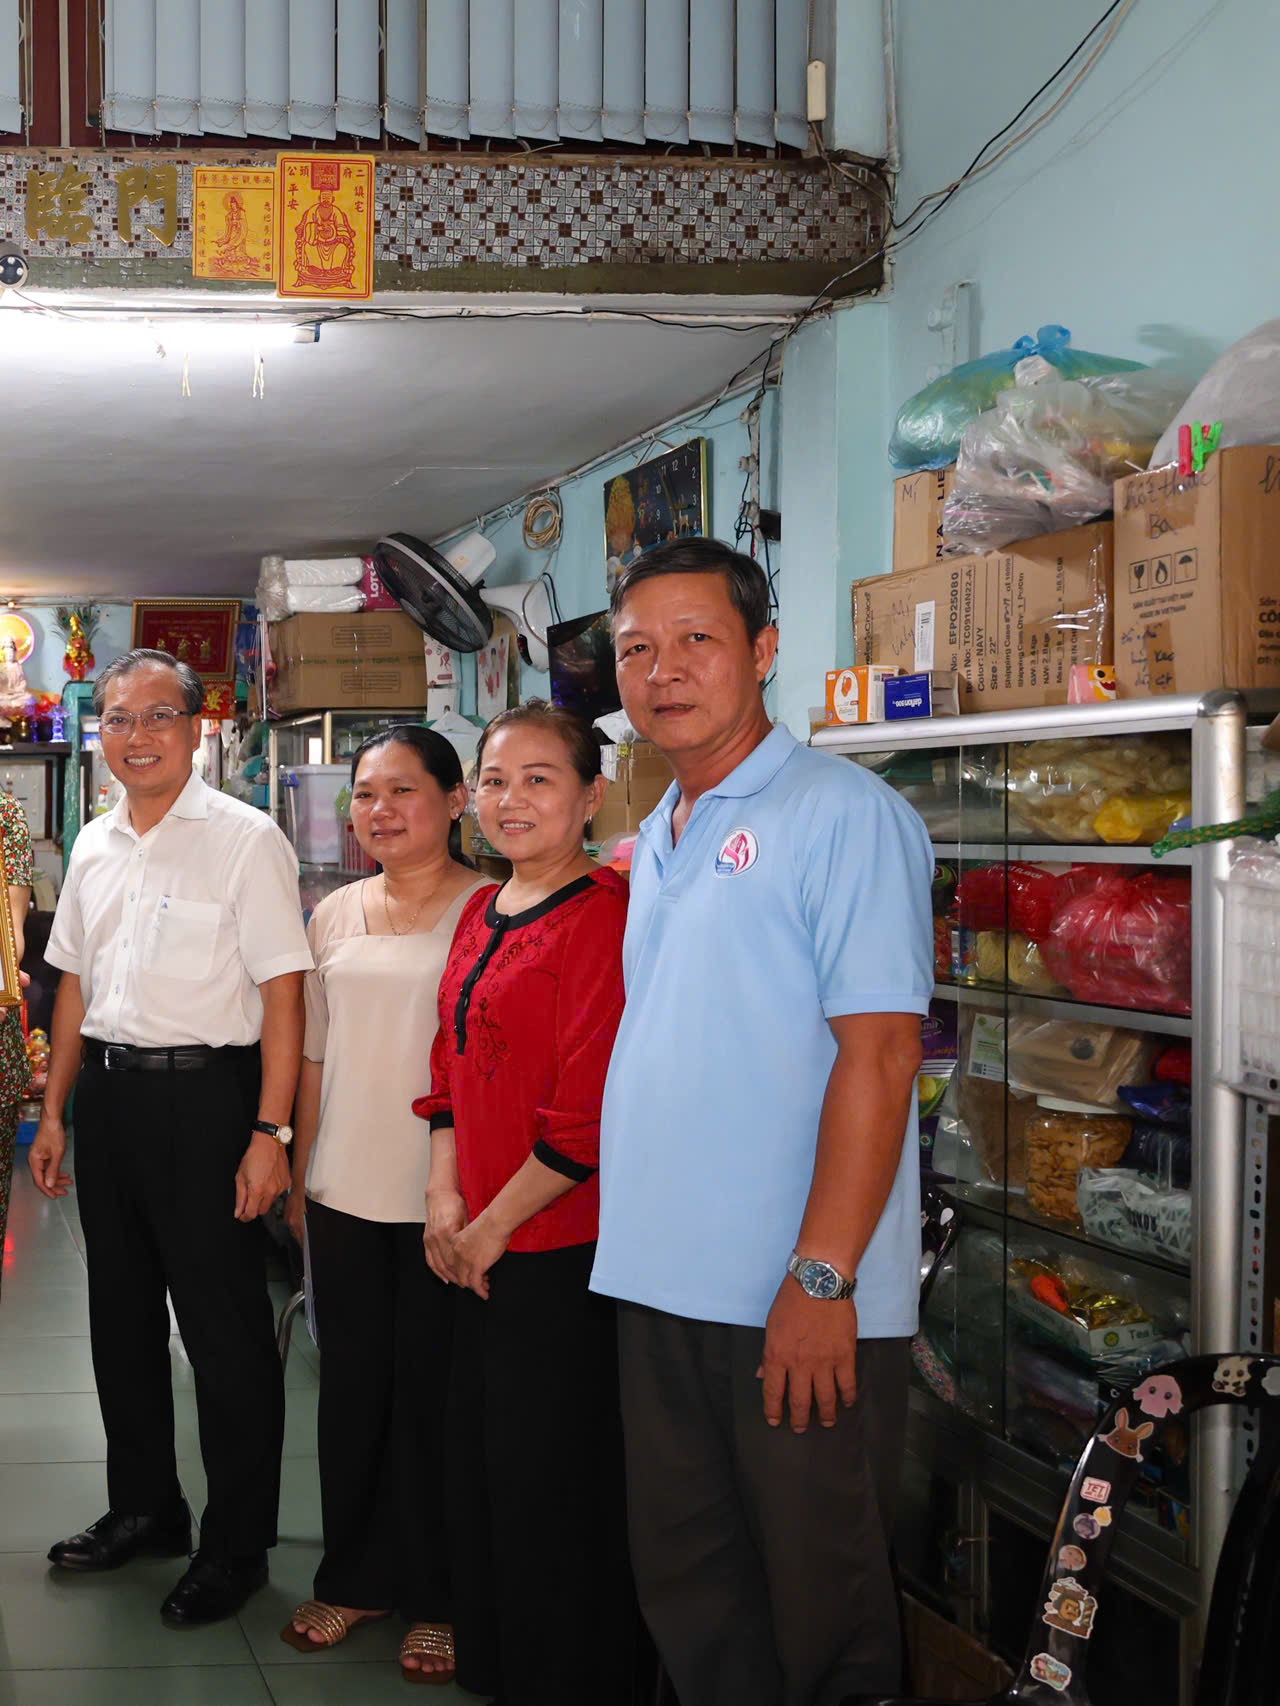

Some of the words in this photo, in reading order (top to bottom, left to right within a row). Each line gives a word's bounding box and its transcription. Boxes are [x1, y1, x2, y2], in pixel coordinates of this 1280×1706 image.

[287, 183, 299, 211] 平安
[976, 627, 984, 656] NAVY
[976, 657, 985, 692] Color:
[1004, 648, 1013, 689] Shipping
